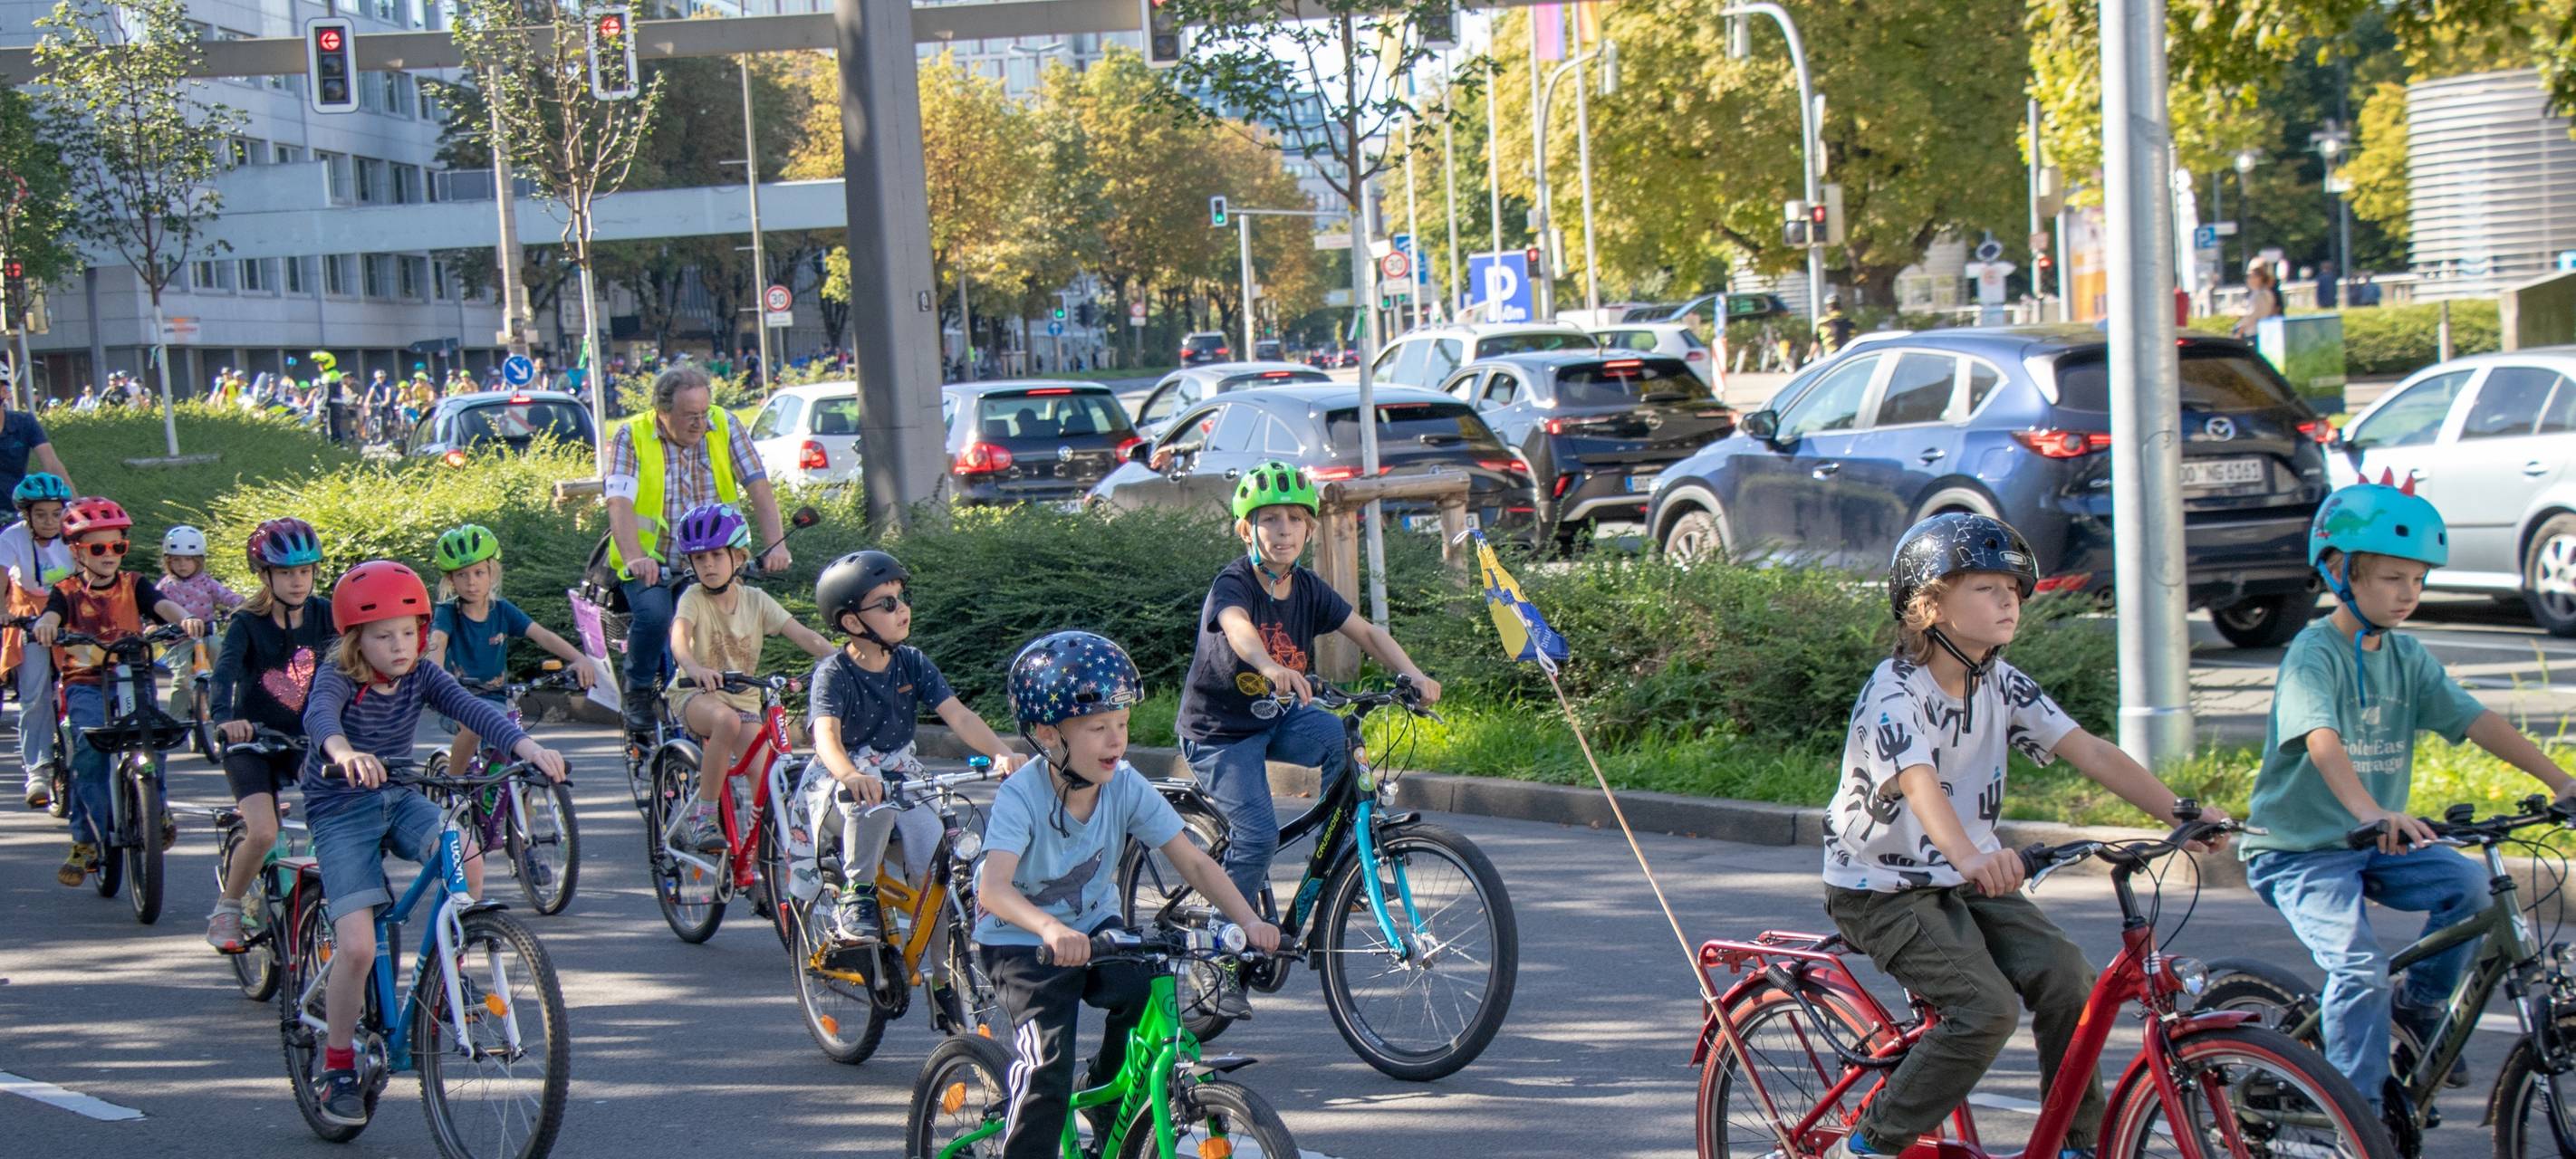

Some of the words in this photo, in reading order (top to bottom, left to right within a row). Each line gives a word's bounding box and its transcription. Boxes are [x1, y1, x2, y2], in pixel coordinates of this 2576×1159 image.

[771, 292, 785, 305] 30
[1315, 807, 1342, 859] CRUSADER
[449, 838, 464, 884] woom
